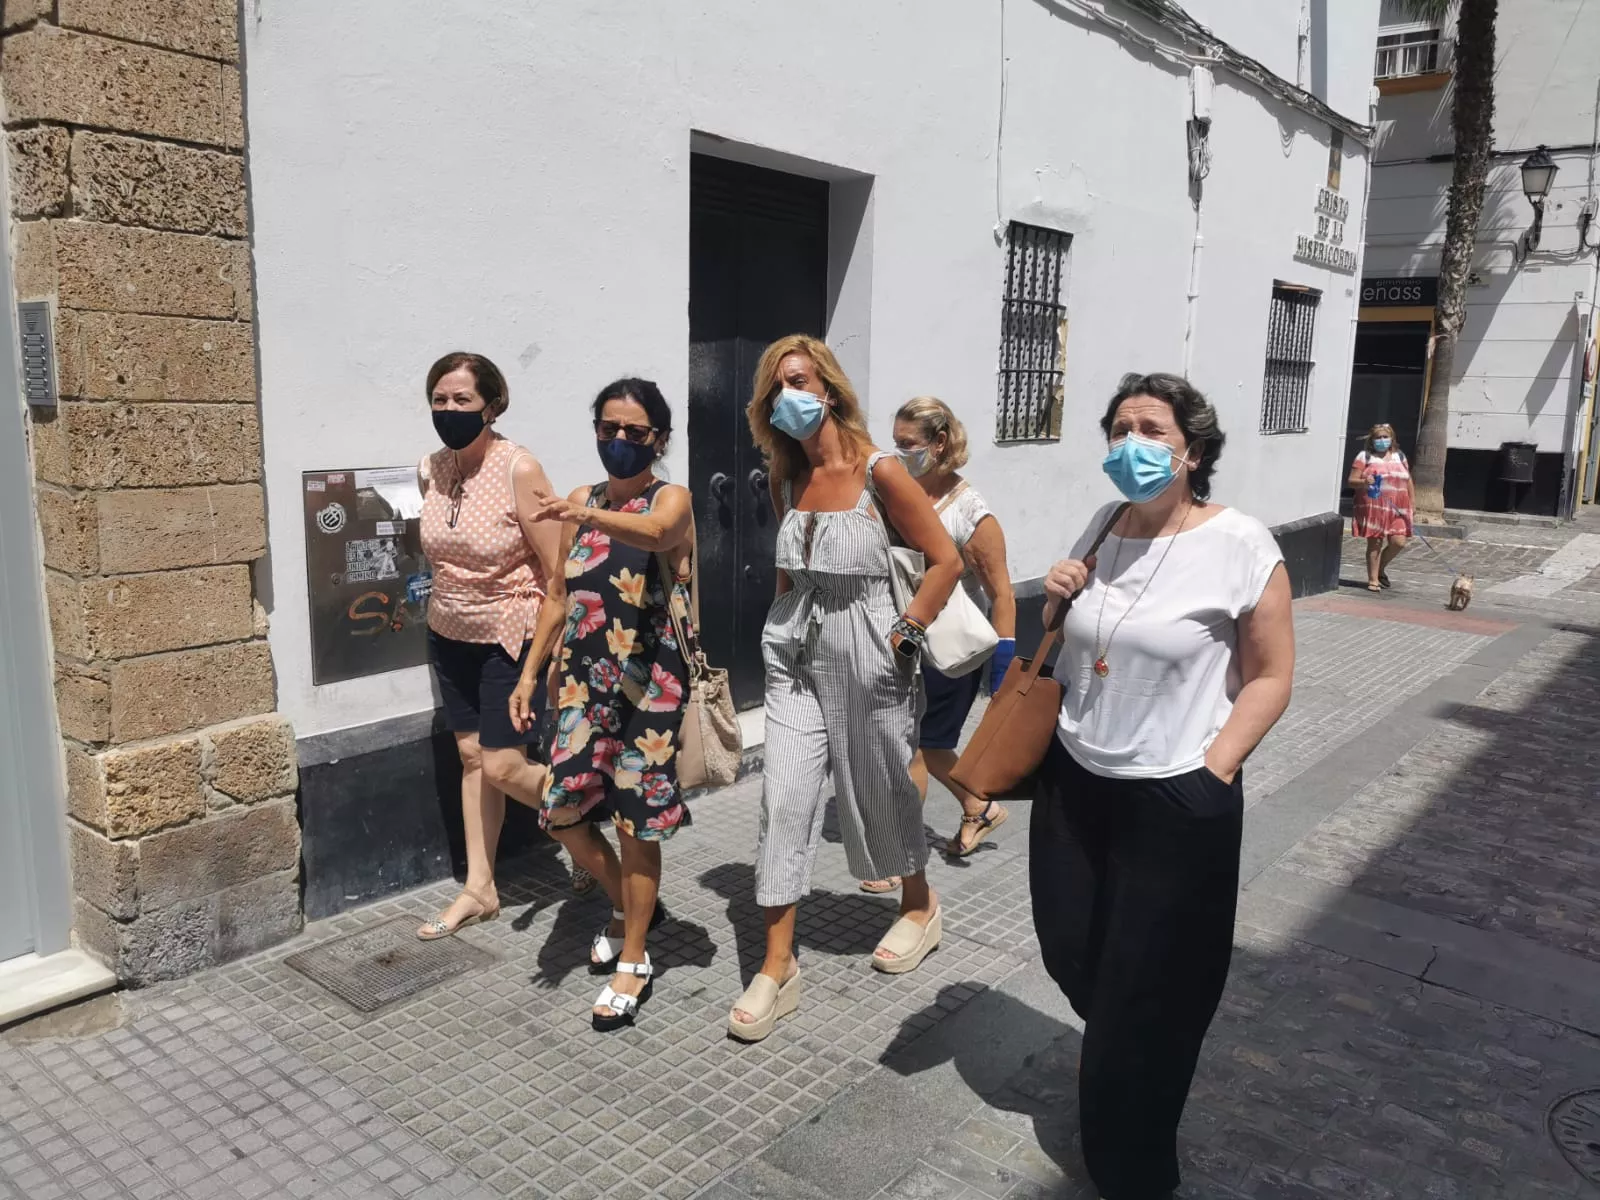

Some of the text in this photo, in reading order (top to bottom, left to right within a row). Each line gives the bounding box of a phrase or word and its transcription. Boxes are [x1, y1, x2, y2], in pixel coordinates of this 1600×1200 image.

[1318, 188, 1349, 218] CRISTO
[1318, 215, 1343, 242] DE LA
[1296, 234, 1357, 270] MISERICORDIA
[1362, 286, 1421, 301] enass
